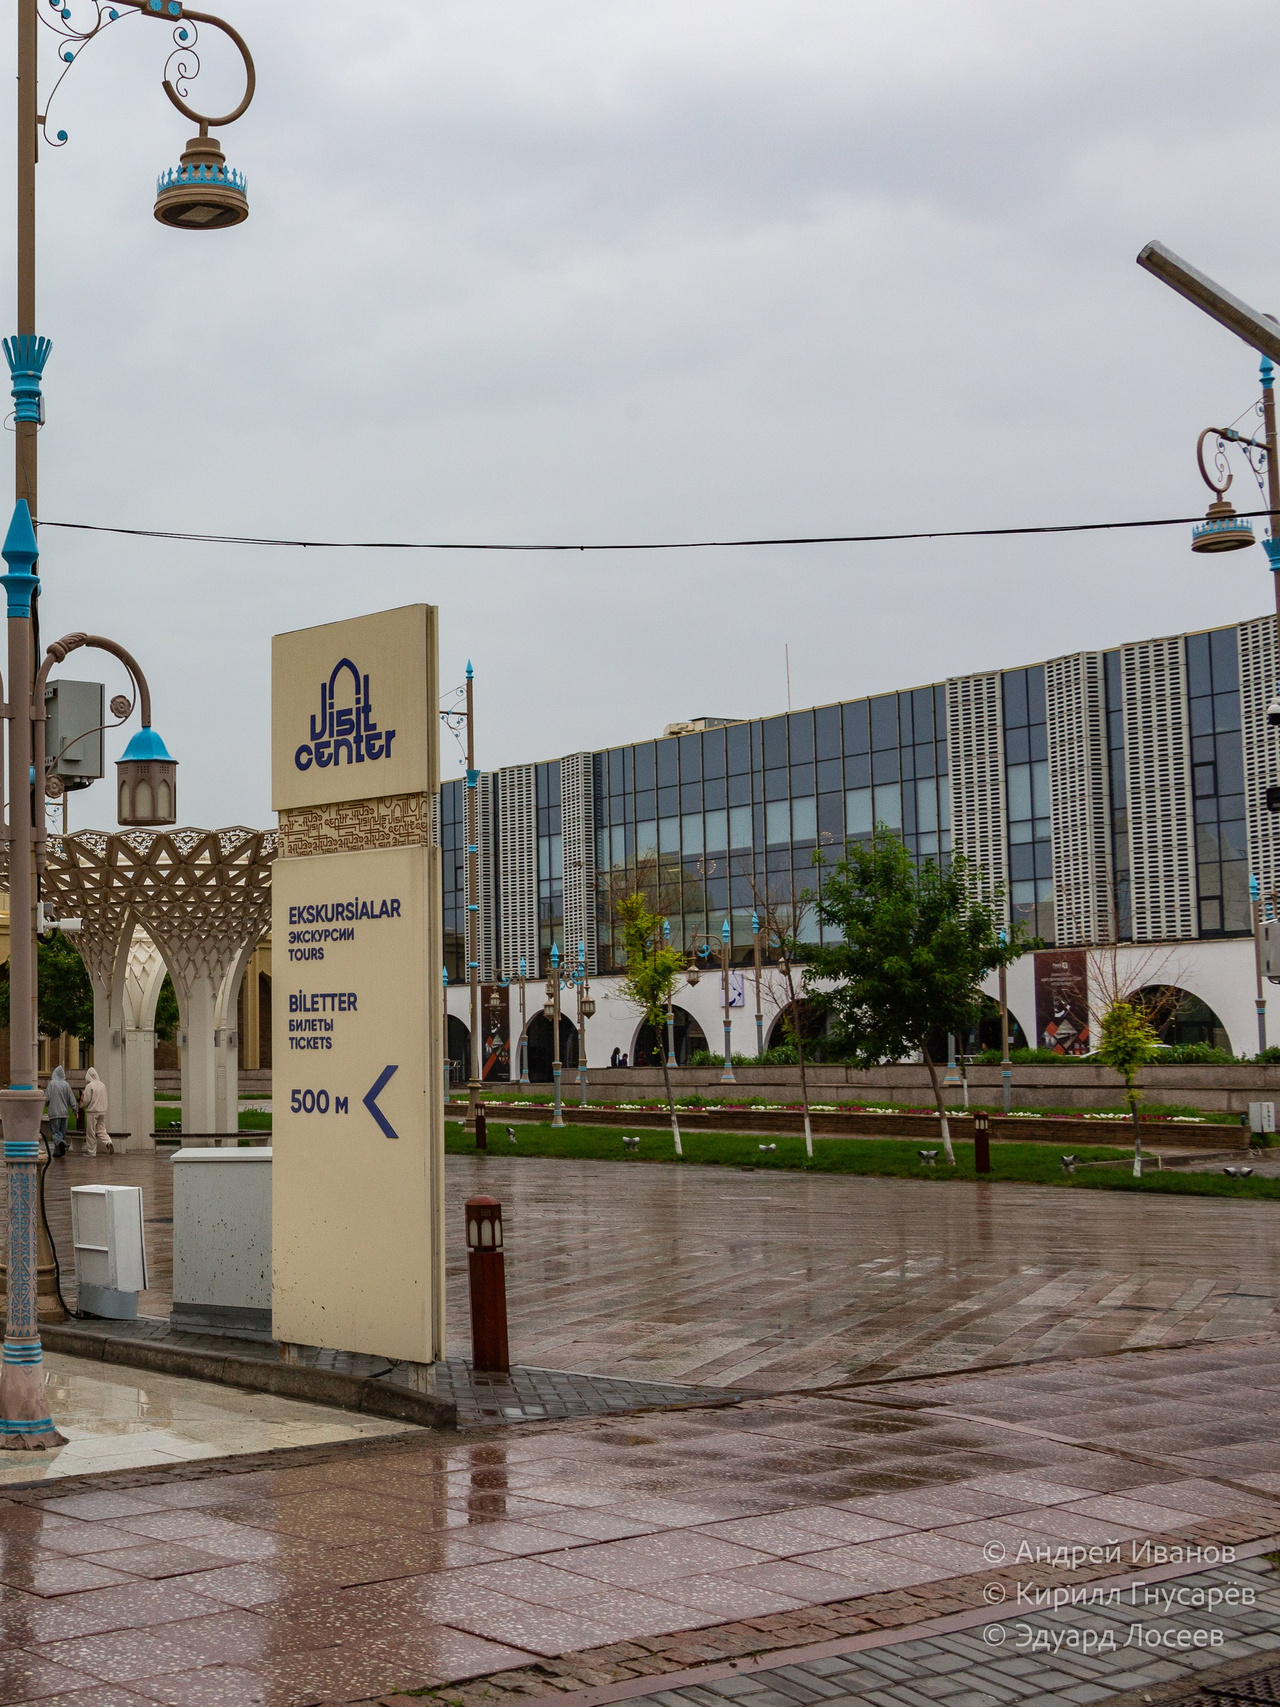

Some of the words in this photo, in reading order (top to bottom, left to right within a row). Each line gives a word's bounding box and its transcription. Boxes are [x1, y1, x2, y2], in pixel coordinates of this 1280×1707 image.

[288, 927, 355, 944] ЭКСКУРСИИ
[288, 947, 324, 962] TOURS
[289, 1018, 333, 1032] БИЛЕТЫ
[289, 1036, 332, 1050] TICKETS
[290, 1089, 330, 1114] 500
